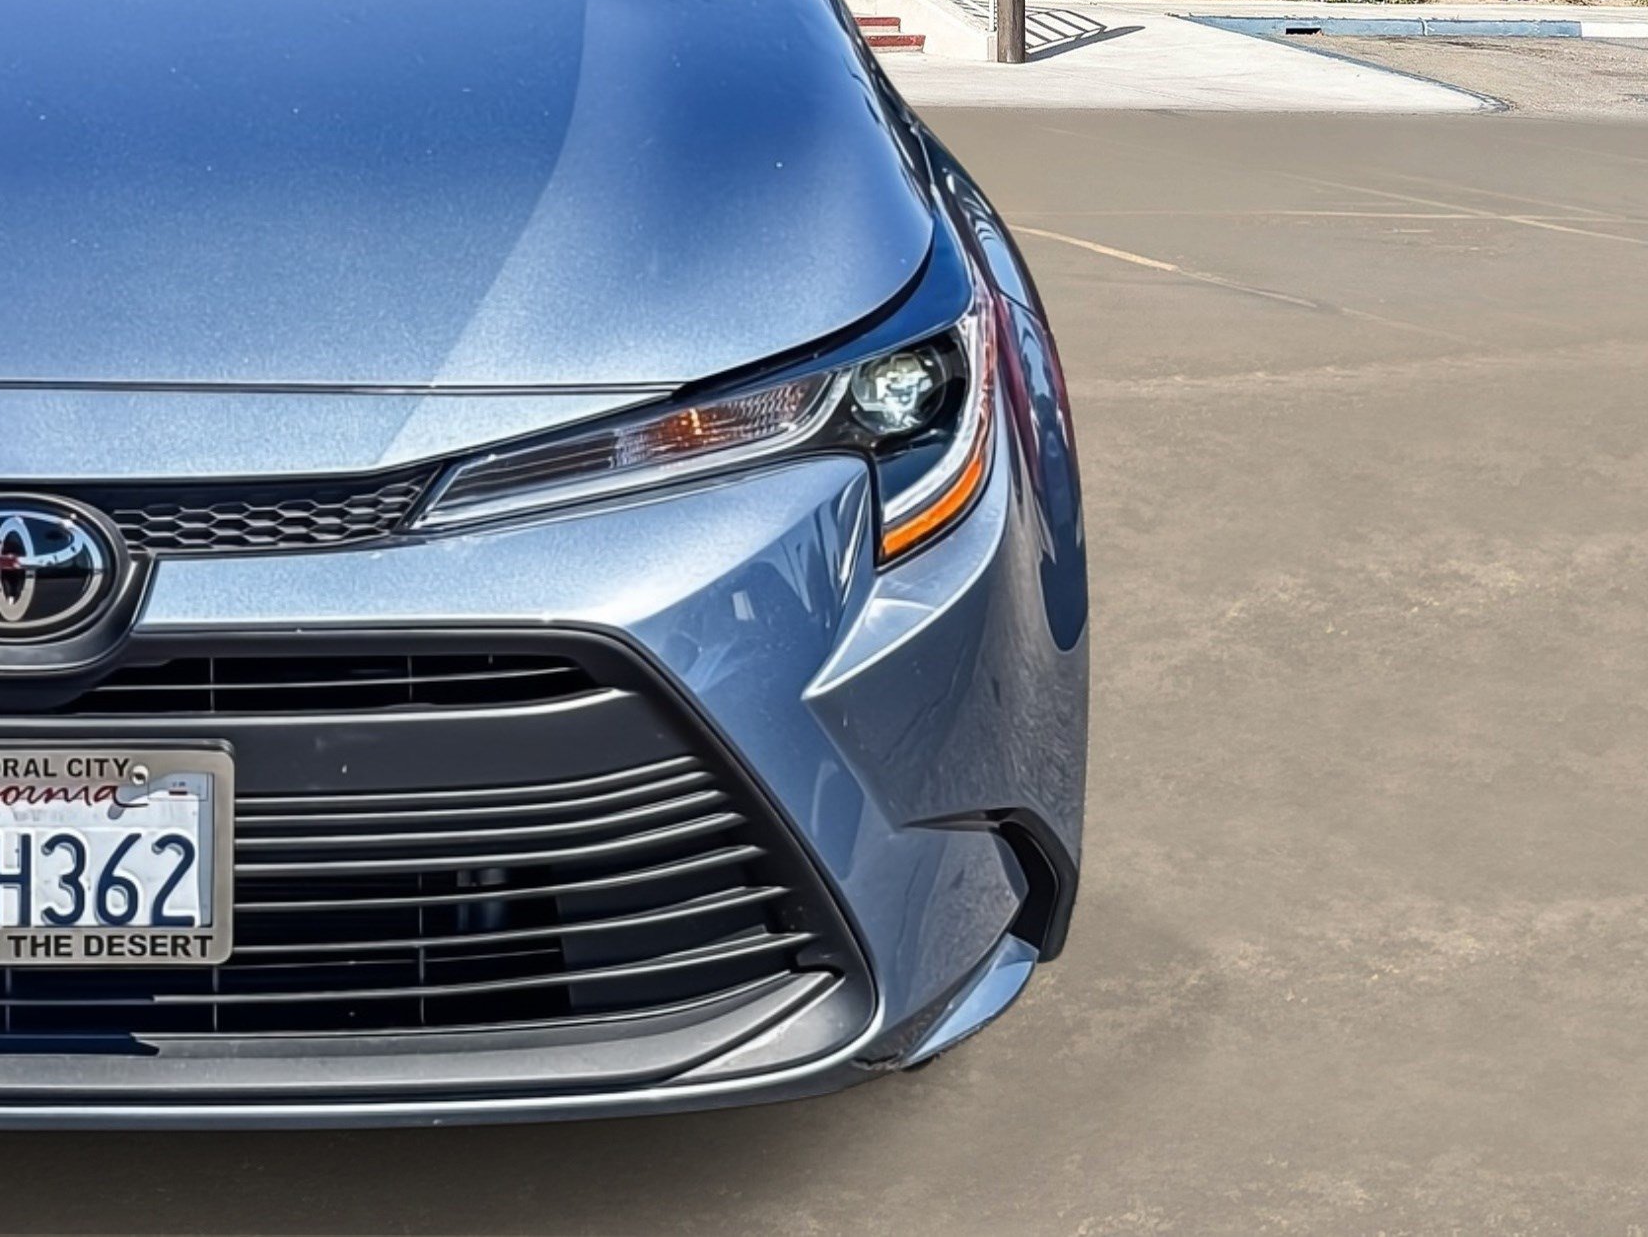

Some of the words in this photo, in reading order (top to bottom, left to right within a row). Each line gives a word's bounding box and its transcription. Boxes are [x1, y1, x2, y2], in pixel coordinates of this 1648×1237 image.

[66, 757, 131, 779] CITY
[7, 935, 73, 958] THE
[83, 934, 213, 958] DESERT
